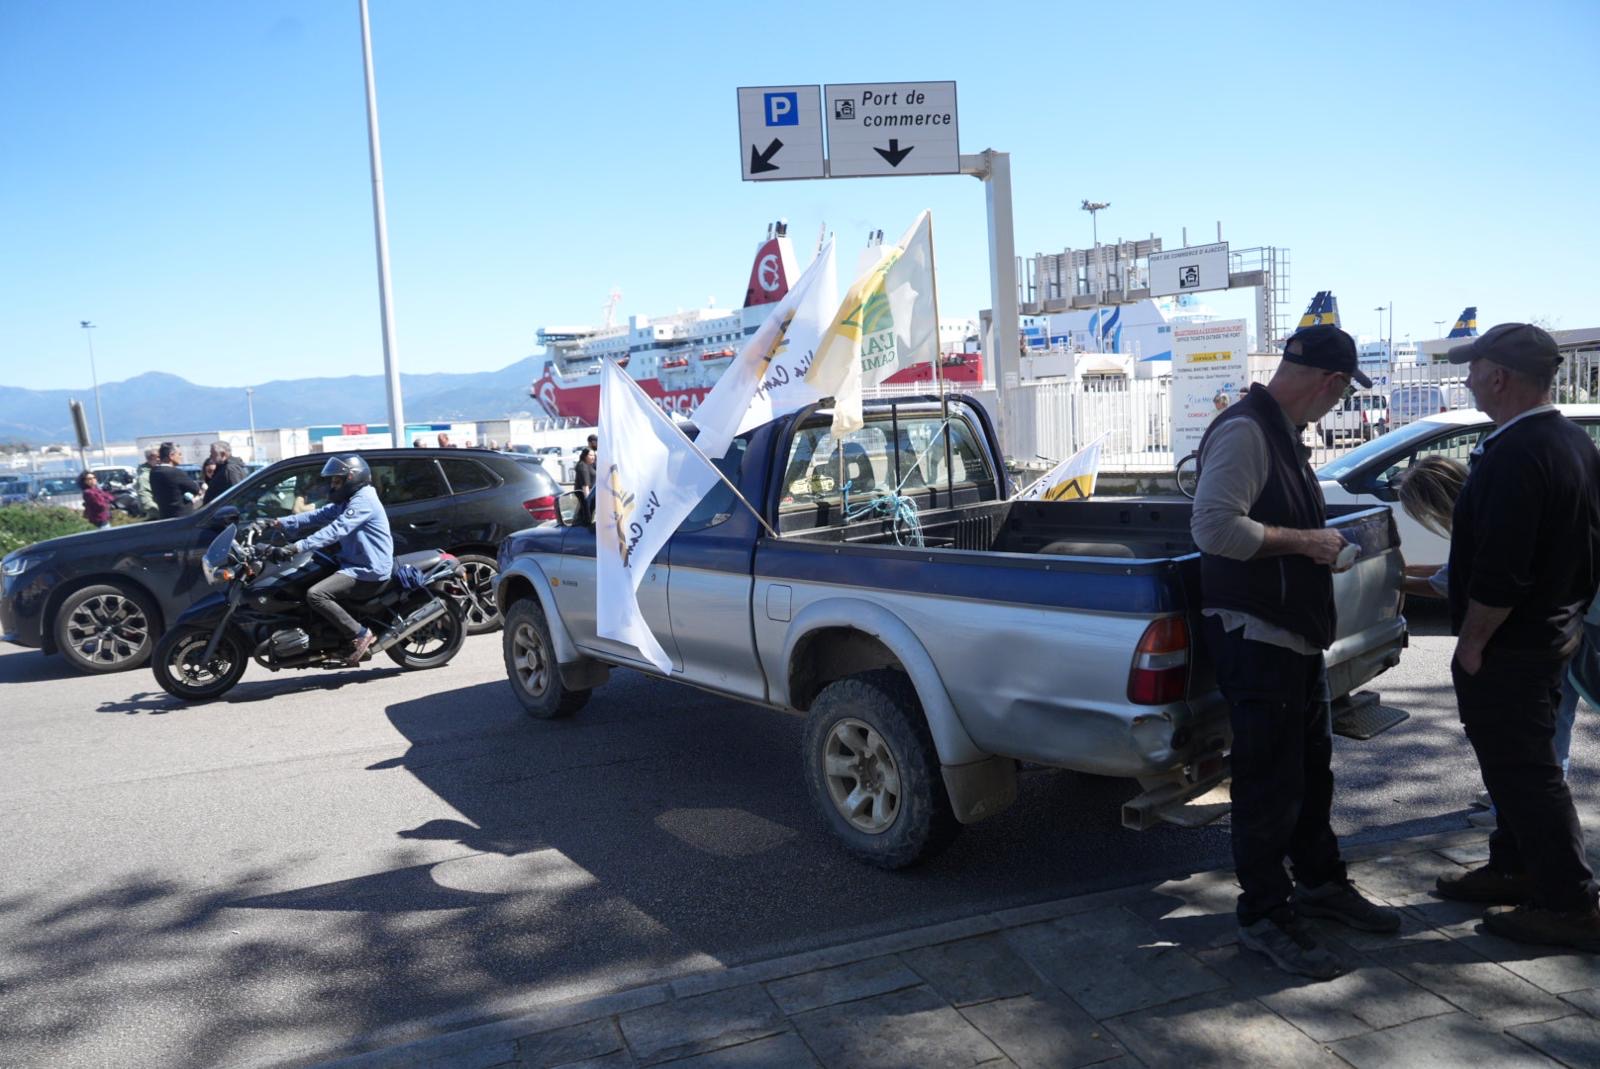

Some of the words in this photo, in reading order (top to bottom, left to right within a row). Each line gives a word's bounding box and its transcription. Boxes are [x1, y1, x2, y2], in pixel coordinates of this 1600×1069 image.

[862, 91, 897, 106] Port
[905, 90, 925, 105] de
[770, 96, 792, 122] P
[863, 112, 951, 127] commerce
[1170, 250, 1198, 259] COMMERCE
